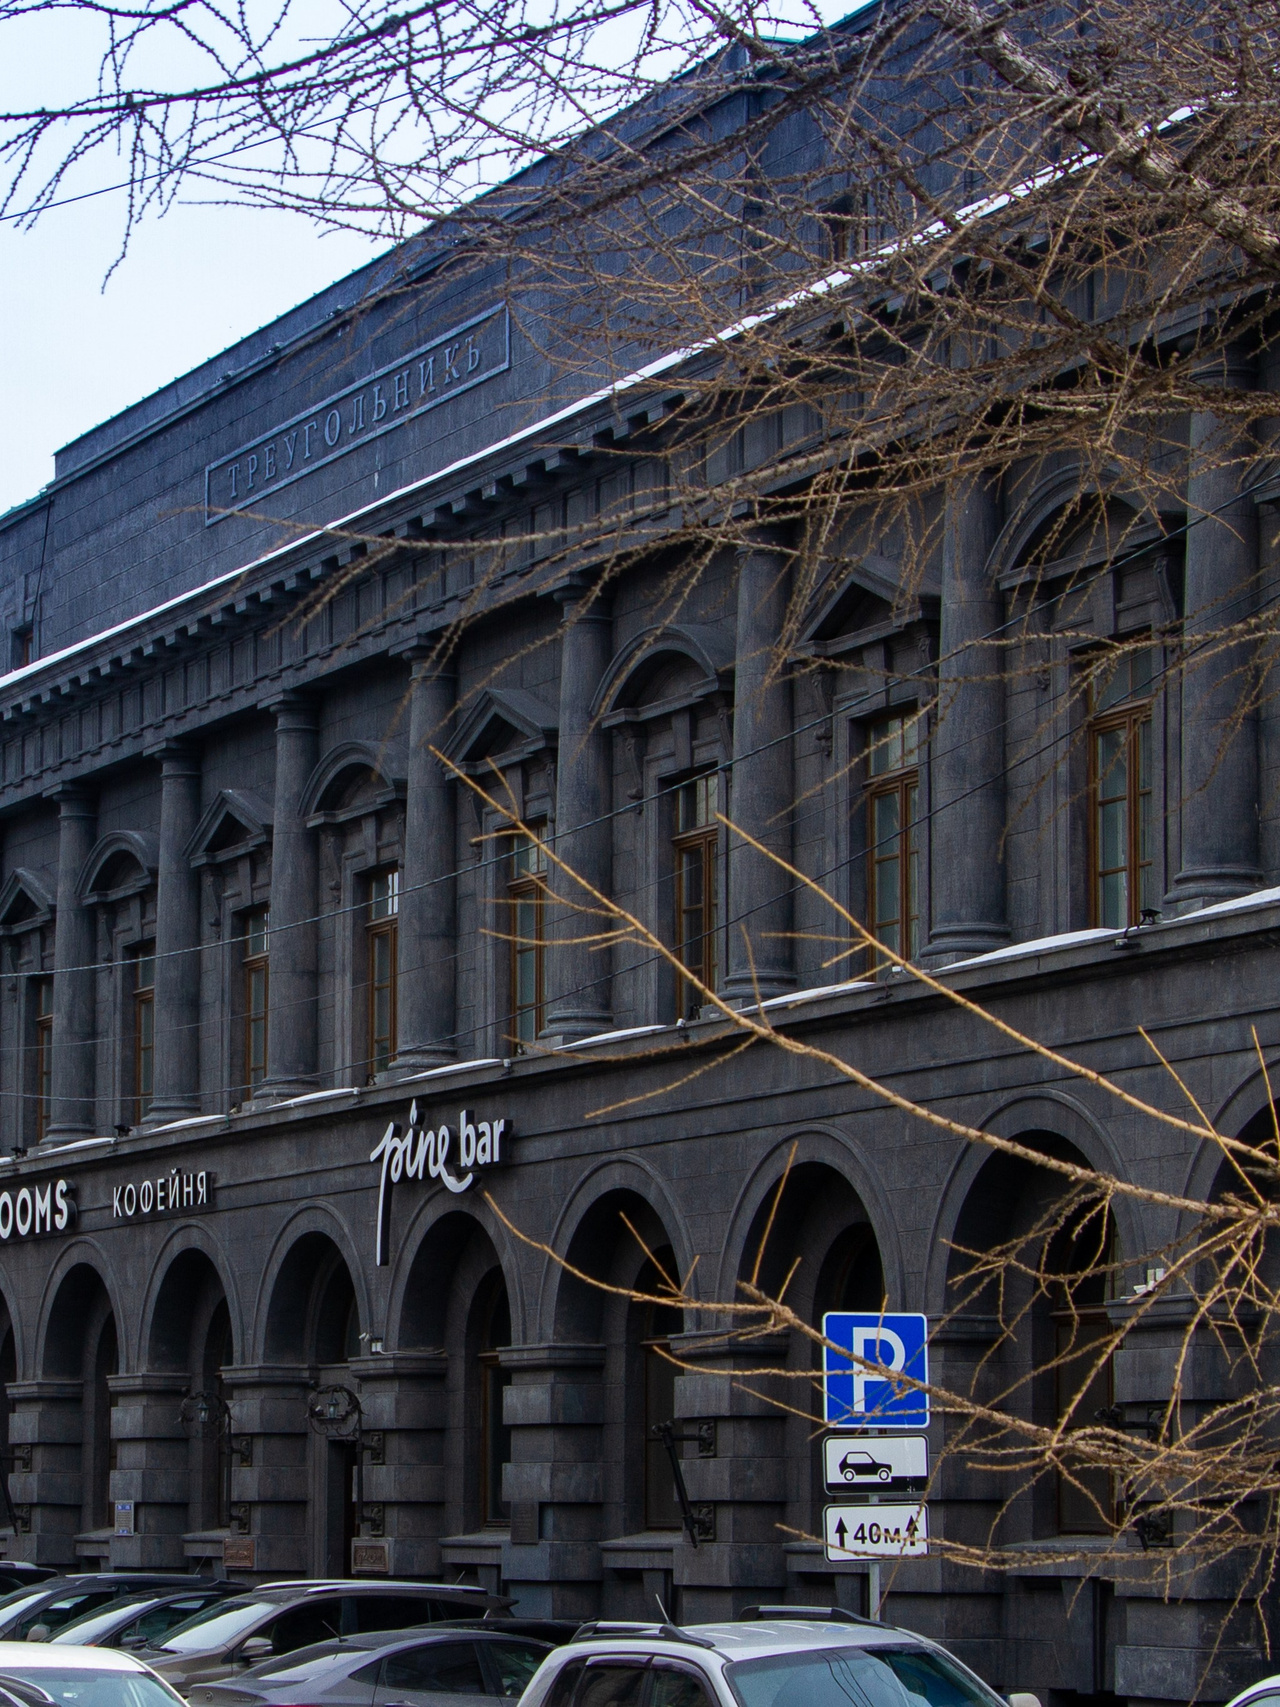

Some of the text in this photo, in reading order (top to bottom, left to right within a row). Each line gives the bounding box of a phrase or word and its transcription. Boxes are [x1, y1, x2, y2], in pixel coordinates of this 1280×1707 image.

[228, 335, 480, 499] ТРЕУГОЛЬНИКЪ
[113, 1167, 207, 1218] КОФЕЙНЯ
[370, 1098, 505, 1267] pine bar
[852, 1326, 906, 1412] P
